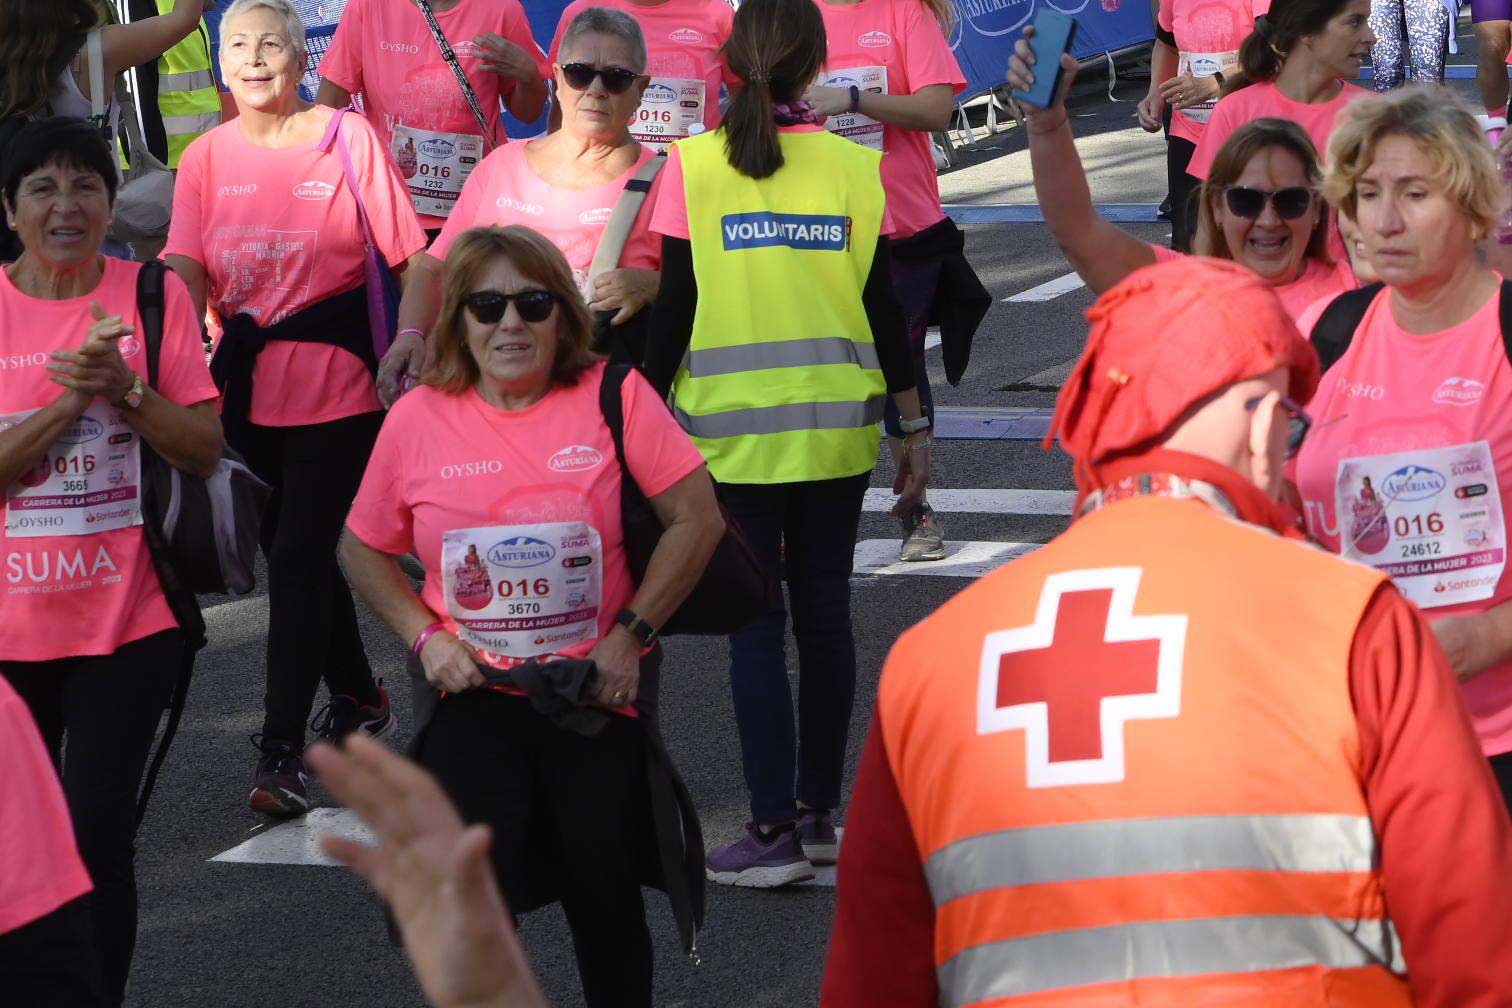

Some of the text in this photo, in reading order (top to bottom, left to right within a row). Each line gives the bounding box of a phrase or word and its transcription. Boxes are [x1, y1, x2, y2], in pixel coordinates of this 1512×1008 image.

[380, 41, 419, 55] OYSHO
[640, 109, 671, 122] 016
[645, 125, 664, 133] 1230
[836, 118, 855, 128] 1228
[419, 163, 451, 178] 016
[423, 178, 444, 189] 1232
[724, 219, 844, 243] VOLUNTARIS
[0, 352, 47, 370] YSHO
[54, 454, 96, 475] 016
[441, 460, 503, 479] OYSHO
[22, 497, 63, 508] CARRERA
[64, 496, 74, 506] DE
[75, 496, 85, 505] LA
[19, 515, 64, 529] OYSHO
[1394, 512, 1445, 537] 016
[561, 540, 590, 549] SUMA
[1401, 541, 1441, 558] 24612
[492, 549, 550, 563] ASTURIANA
[6, 544, 117, 583] SUMA
[1406, 564, 1420, 574] DE
[1421, 563, 1433, 572] LA
[1434, 558, 1468, 571] MUJER
[497, 577, 550, 598] 016
[508, 603, 541, 615] 3670
[465, 620, 507, 630] CARRERA
[508, 620, 521, 628] DE
[522, 619, 534, 627] LA
[536, 616, 566, 627] MUJER
